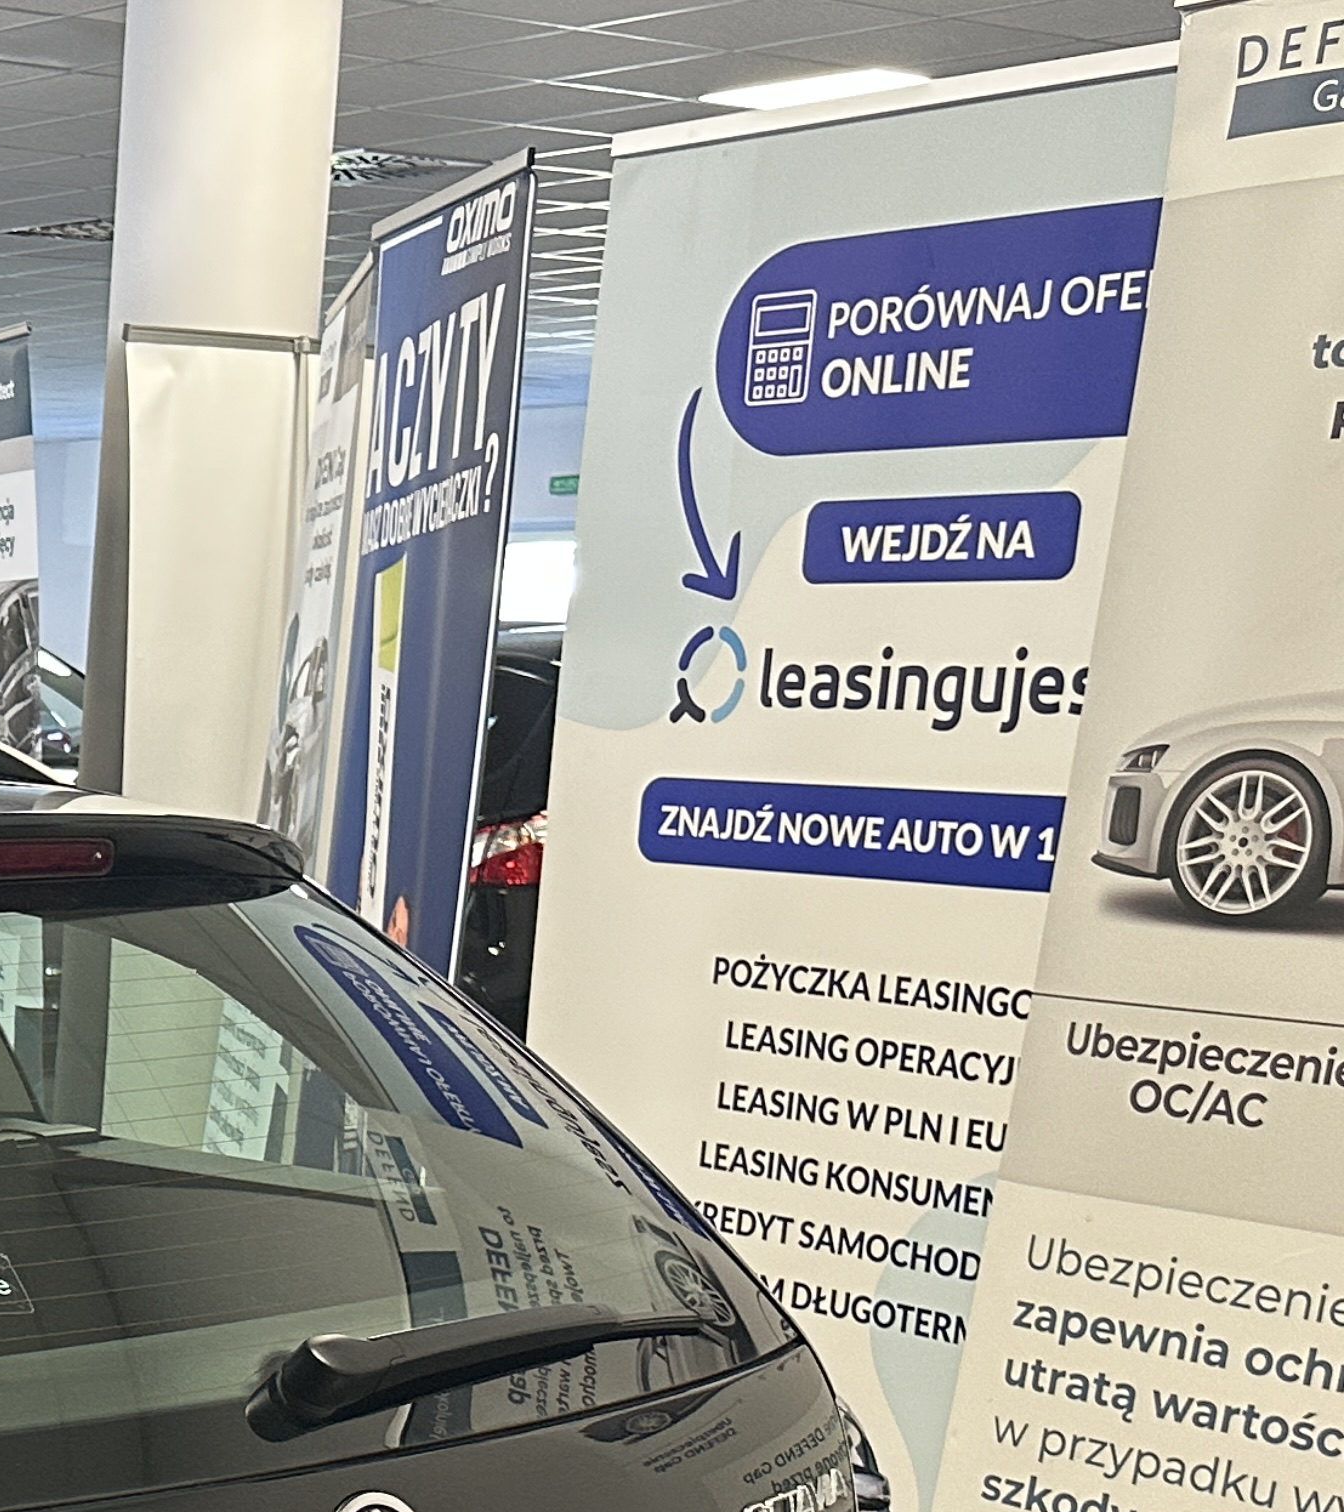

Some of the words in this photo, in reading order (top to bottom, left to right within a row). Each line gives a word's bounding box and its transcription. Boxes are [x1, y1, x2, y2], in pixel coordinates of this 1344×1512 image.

[828, 279, 1053, 339] PORÓWNAJ
[1061, 270, 1153, 316] OFE
[821, 347, 974, 398] ONLINE
[842, 514, 972, 562] WEJDŹ
[976, 520, 1035, 559] NA
[657, 804, 772, 843] ZNAJDŹ
[778, 813, 884, 850] NOWE
[888, 818, 983, 856] AUTO
[990, 824, 1031, 861] W
[712, 953, 871, 1002] POŻYCZKA
[725, 1020, 849, 1063] LEASING
[855, 1036, 1022, 1086] OPERACYJ
[717, 1081, 840, 1127] LEASING
[846, 1099, 880, 1132] W
[883, 1106, 943, 1144] PLN
[949, 1116, 960, 1146] I
[965, 1118, 1008, 1152] EU
[1129, 1079, 1269, 1128] OC/AC
[699, 1140, 819, 1187] LEASING
[694, 1199, 794, 1246] REDYT
[798, 1220, 982, 1281] SAMOCHOD
[1013, 1300, 1229, 1369] zapewnia
[1004, 1358, 1137, 1424] utratą
[1153, 1389, 1344, 1458] wartośc
[994, 1415, 1029, 1448] w
[1038, 1427, 1277, 1509] przypadku
